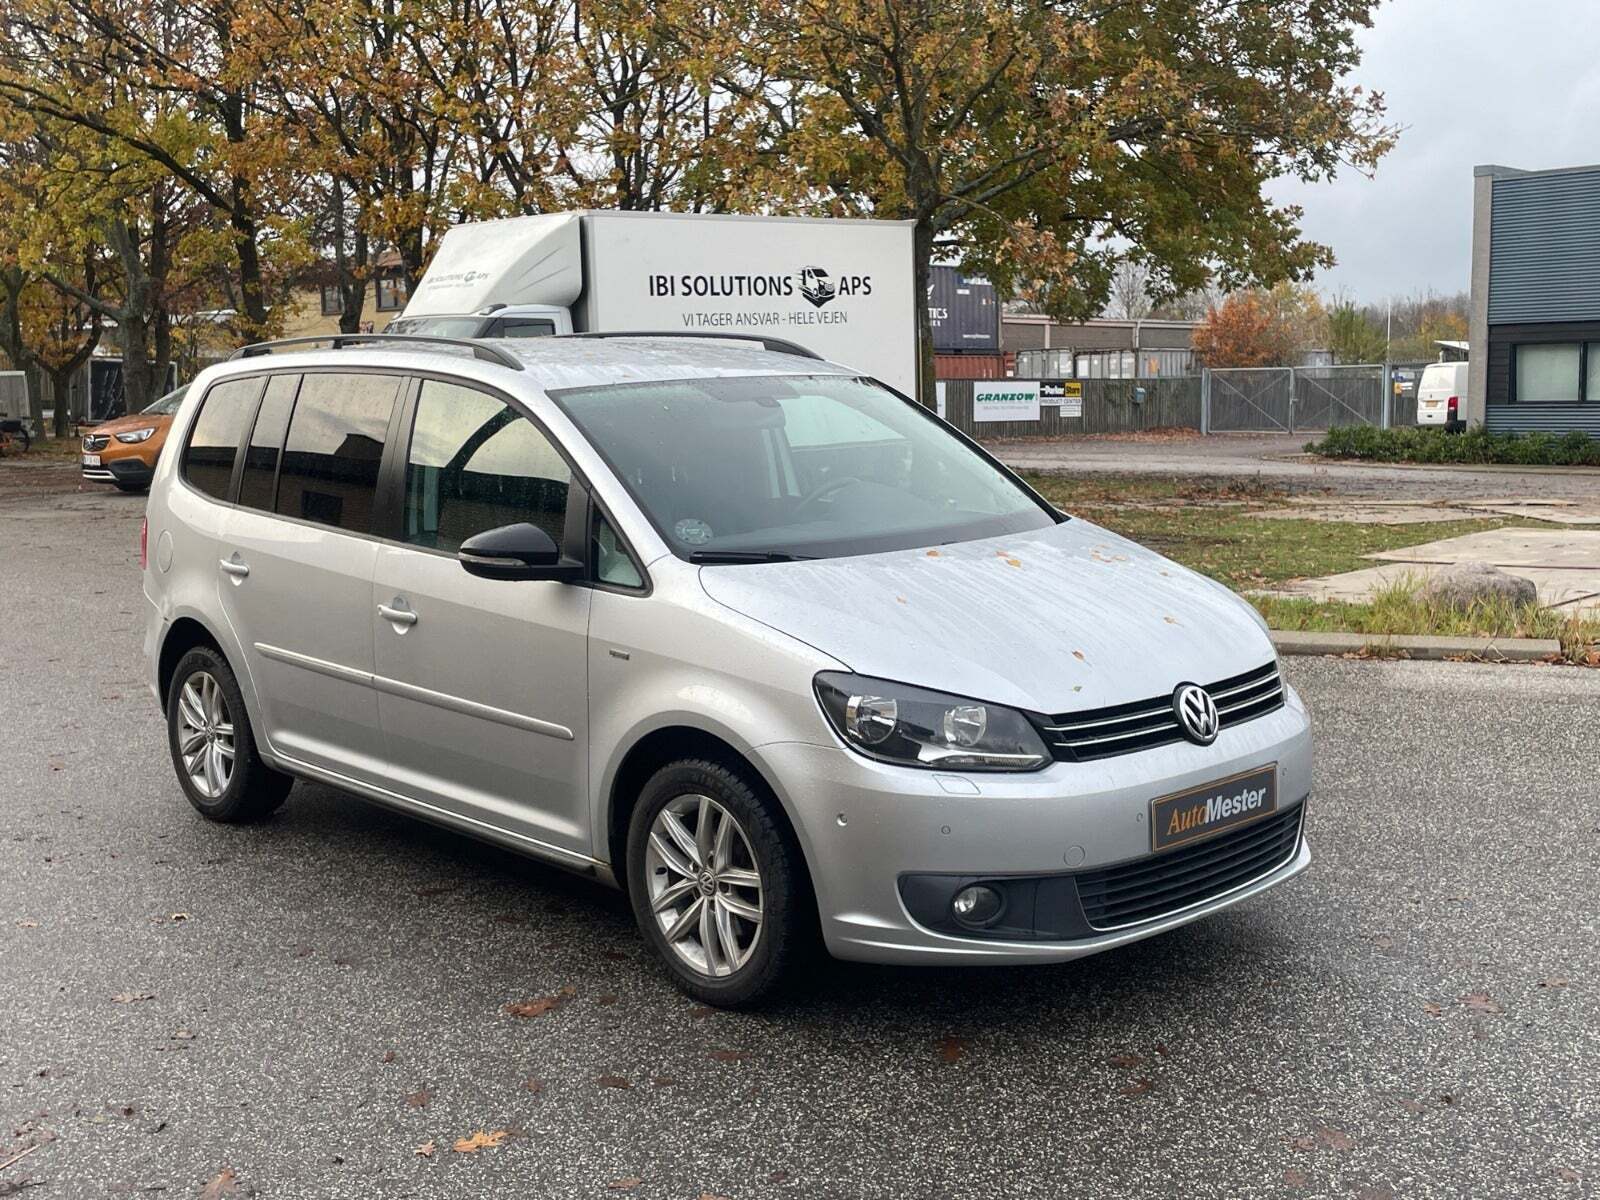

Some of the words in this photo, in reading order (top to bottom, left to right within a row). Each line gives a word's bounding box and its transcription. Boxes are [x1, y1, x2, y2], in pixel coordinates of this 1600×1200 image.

[649, 275, 675, 297] IBI
[681, 275, 793, 297] SOLUTIONS
[838, 275, 872, 296] APS
[682, 313, 694, 327] VI
[695, 312, 733, 326] TAGER
[735, 312, 780, 326] ANSVAR
[789, 311, 814, 325] HELE
[813, 310, 848, 325] VEJEN
[976, 393, 1035, 402] GRANZOW
[1166, 787, 1266, 836] AutoMester
